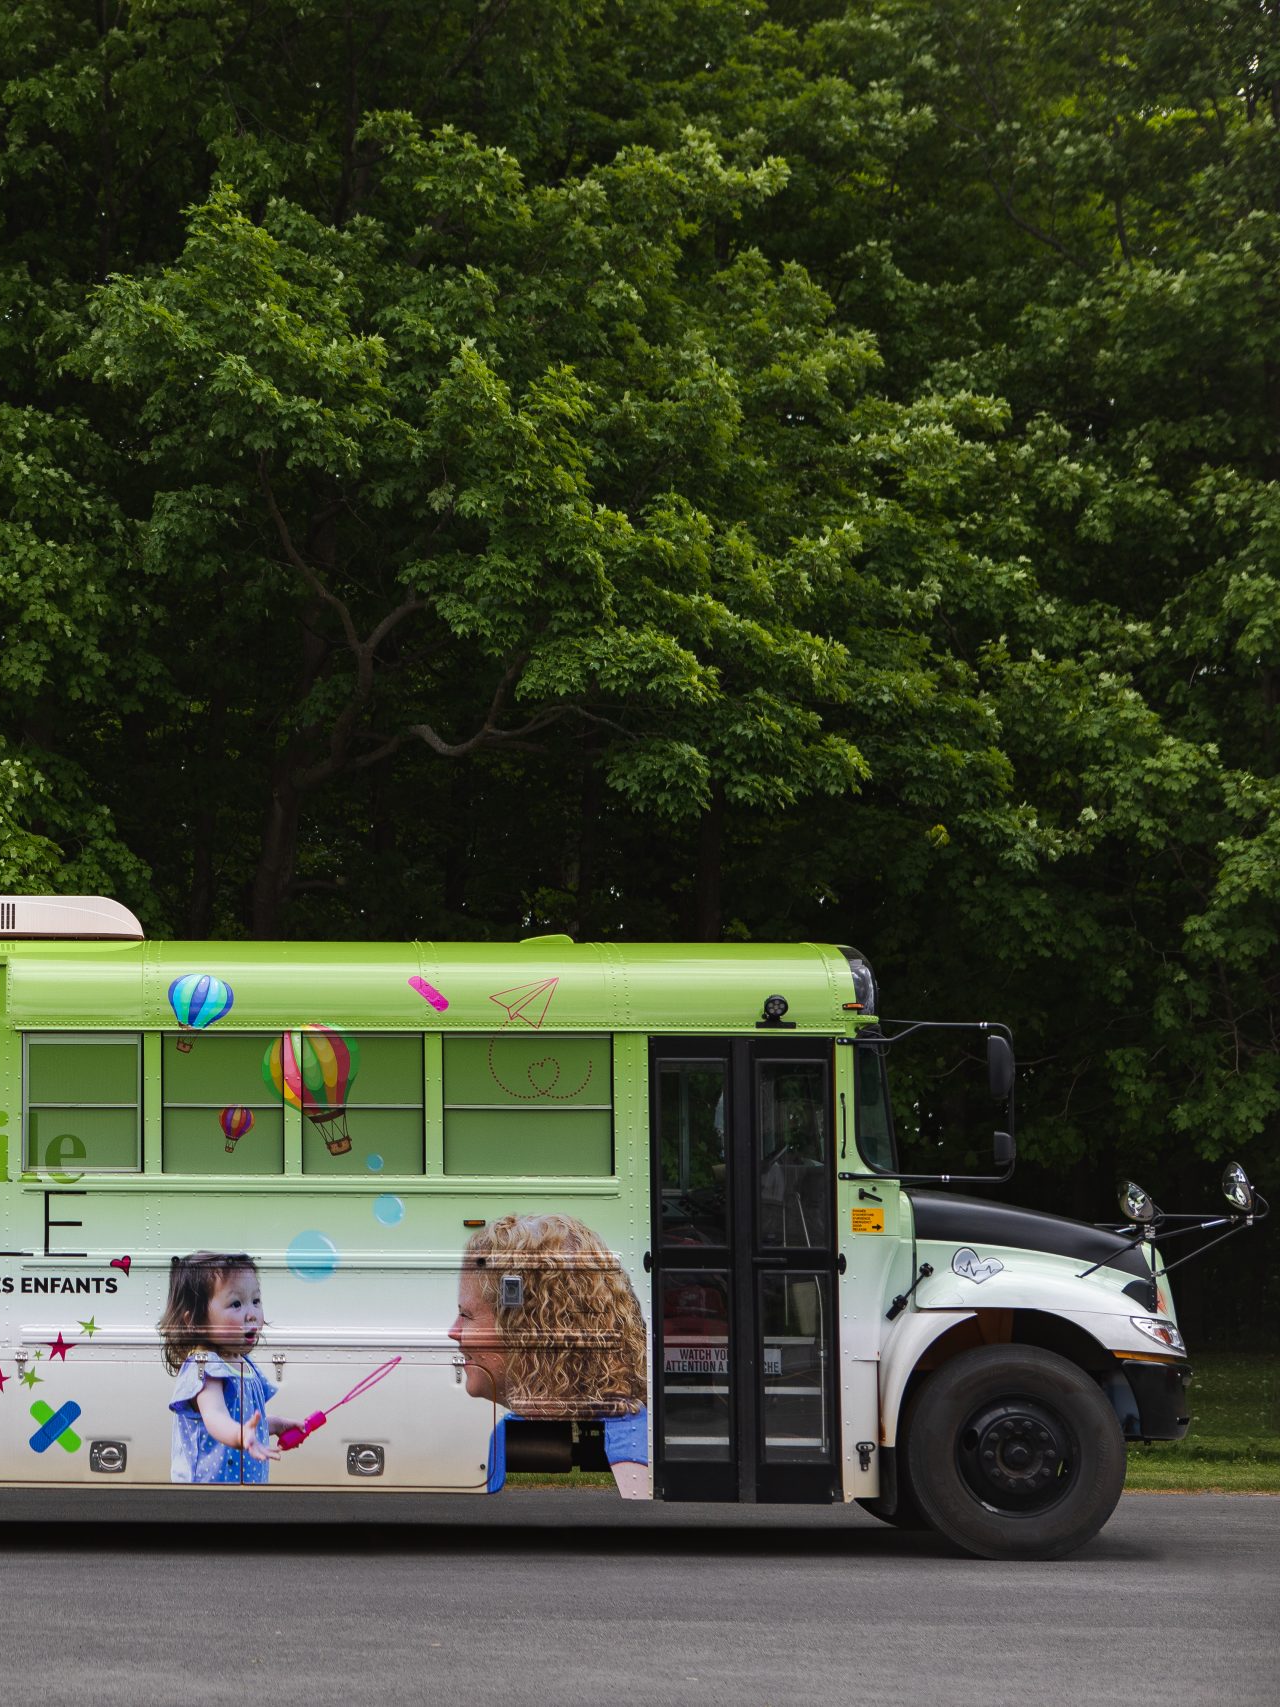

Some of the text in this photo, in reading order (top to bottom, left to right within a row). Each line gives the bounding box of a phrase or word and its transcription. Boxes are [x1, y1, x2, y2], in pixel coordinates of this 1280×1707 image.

[21, 1276, 118, 1294] ENFANTS
[680, 1349, 726, 1360] WATCH YO
[665, 1360, 724, 1372] ATTENTION A
